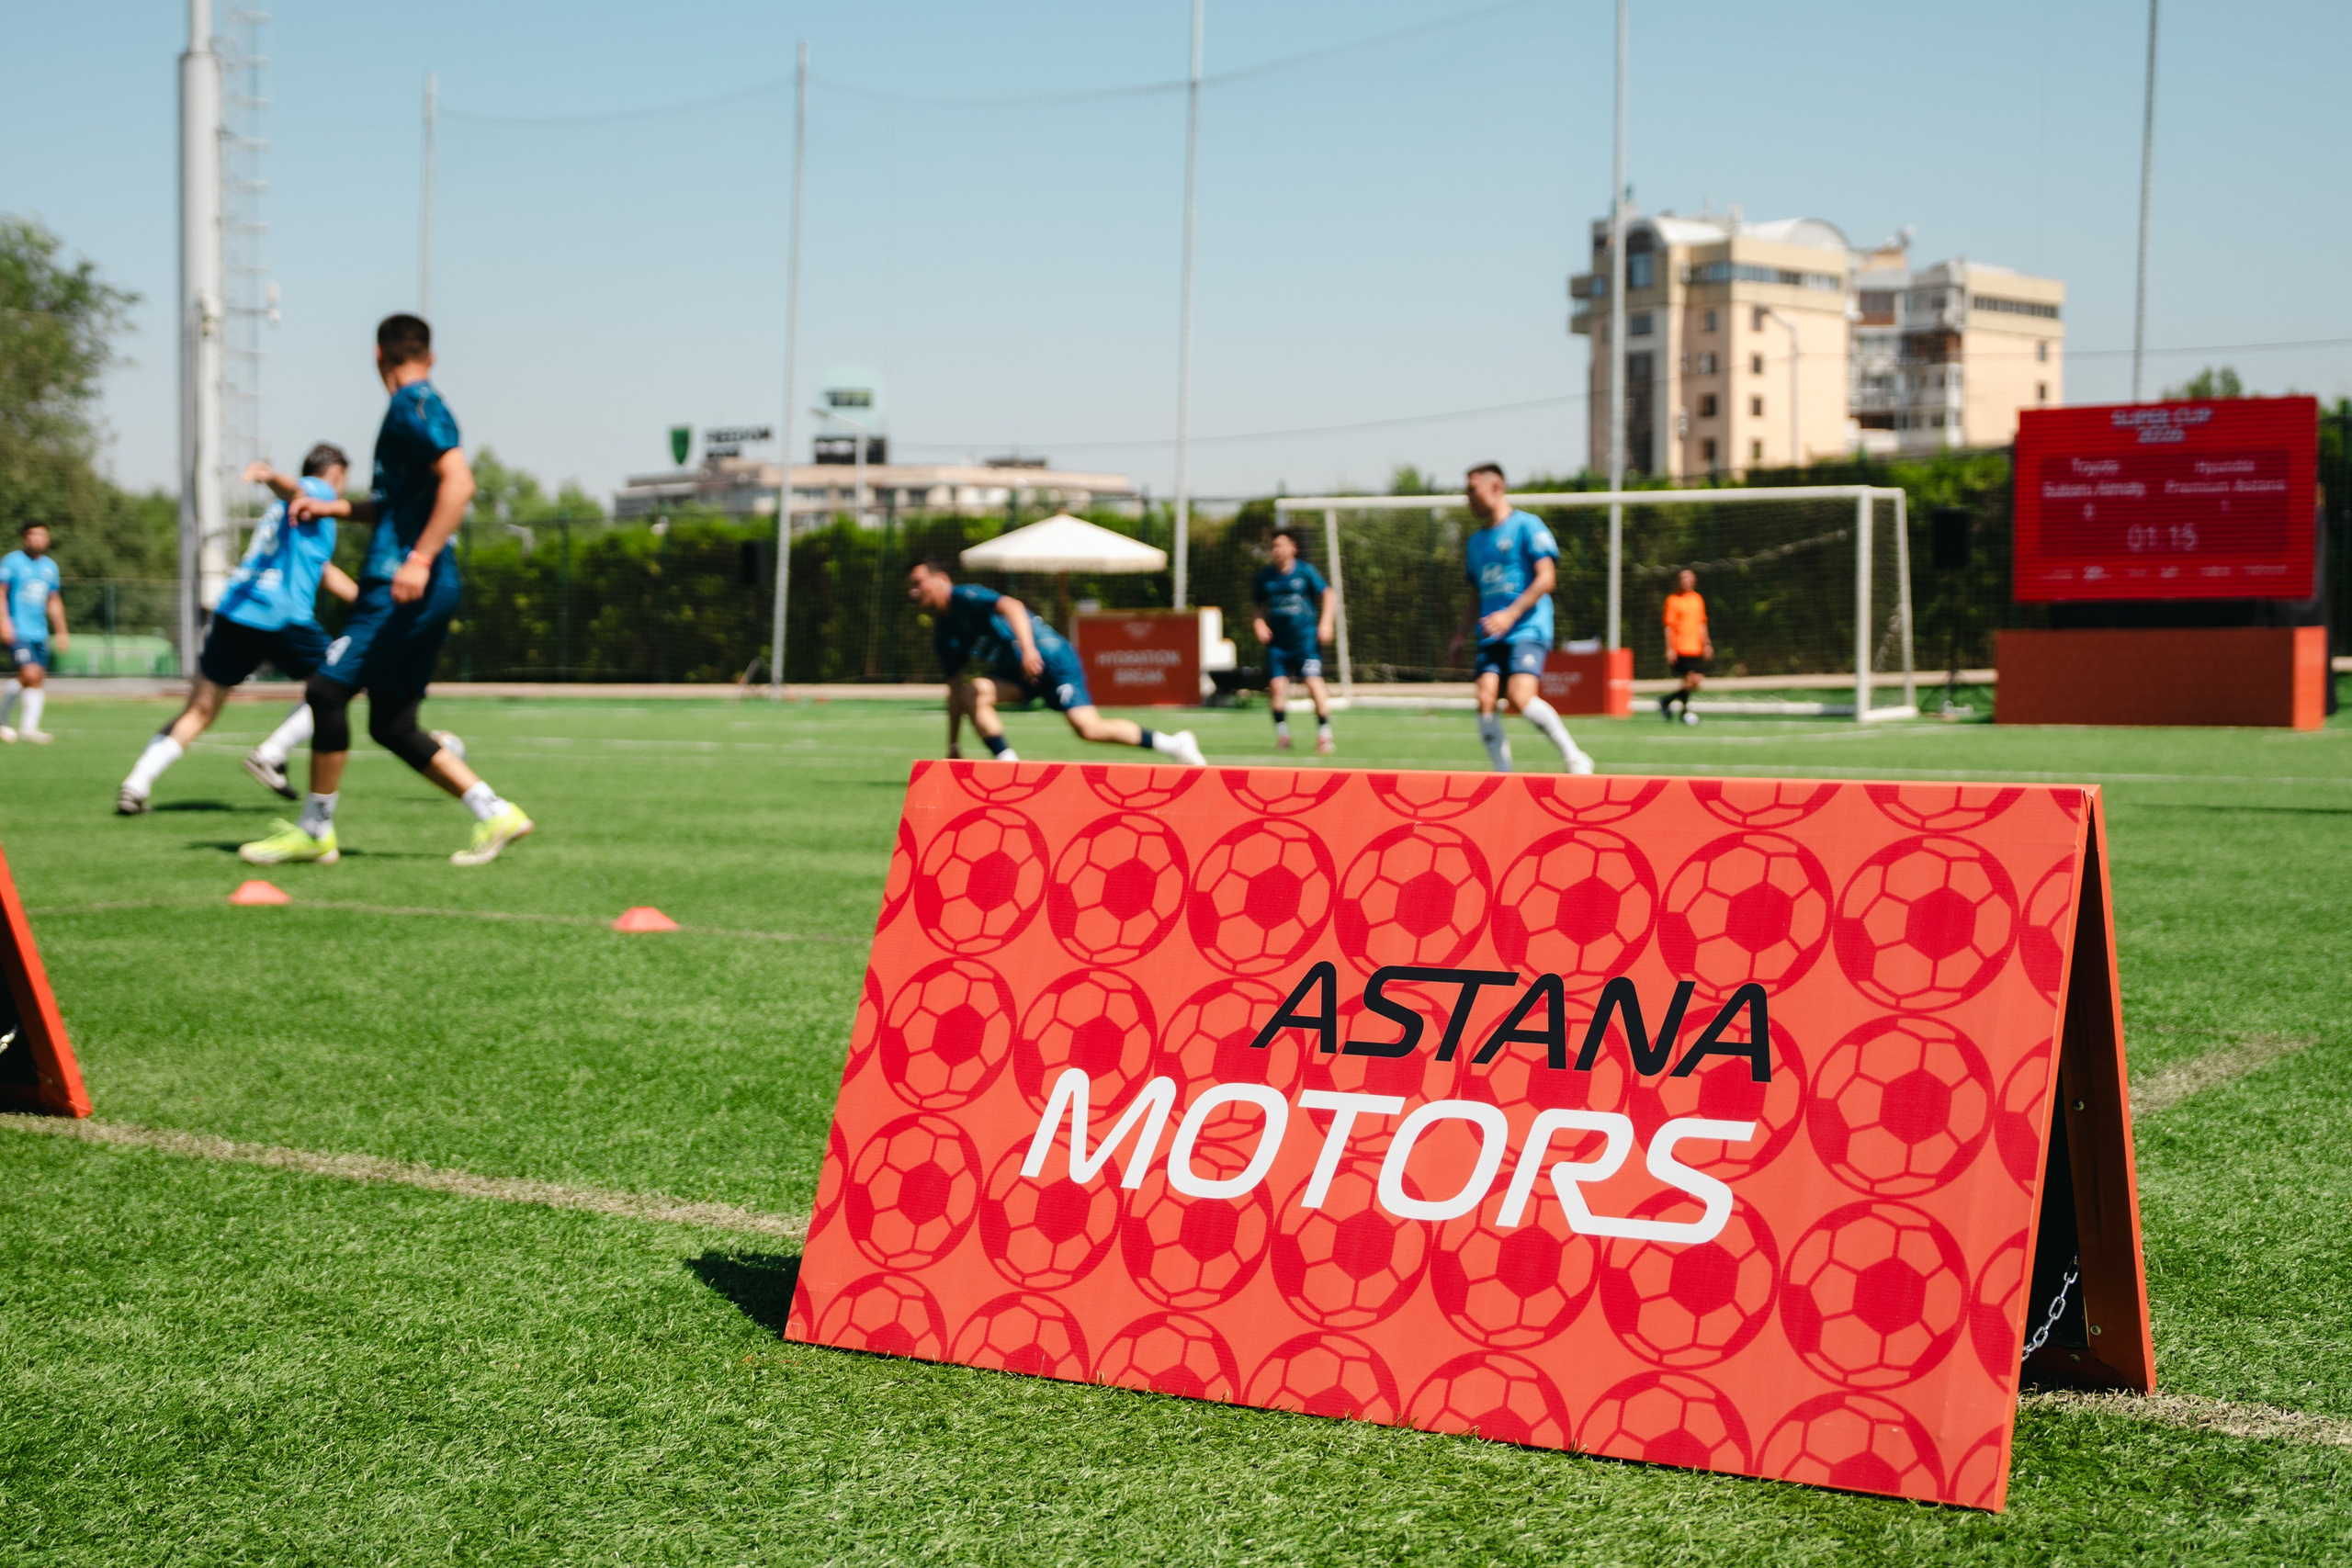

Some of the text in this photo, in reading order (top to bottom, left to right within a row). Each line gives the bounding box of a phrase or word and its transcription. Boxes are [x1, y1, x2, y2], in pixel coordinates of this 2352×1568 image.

[2111, 407, 2213, 426] SUPER CUP
[2071, 457, 2120, 477] Toyota
[2194, 459, 2256, 478] Hyundai
[2093, 479, 2147, 500] Almaty
[2164, 478, 2288, 494] Premium Astana
[1095, 649, 1182, 667] HYDRATION
[1114, 668, 1168, 686] BREAK
[1250, 961, 1772, 1083] ASTANA
[1019, 1067, 1758, 1245] MOTORS
